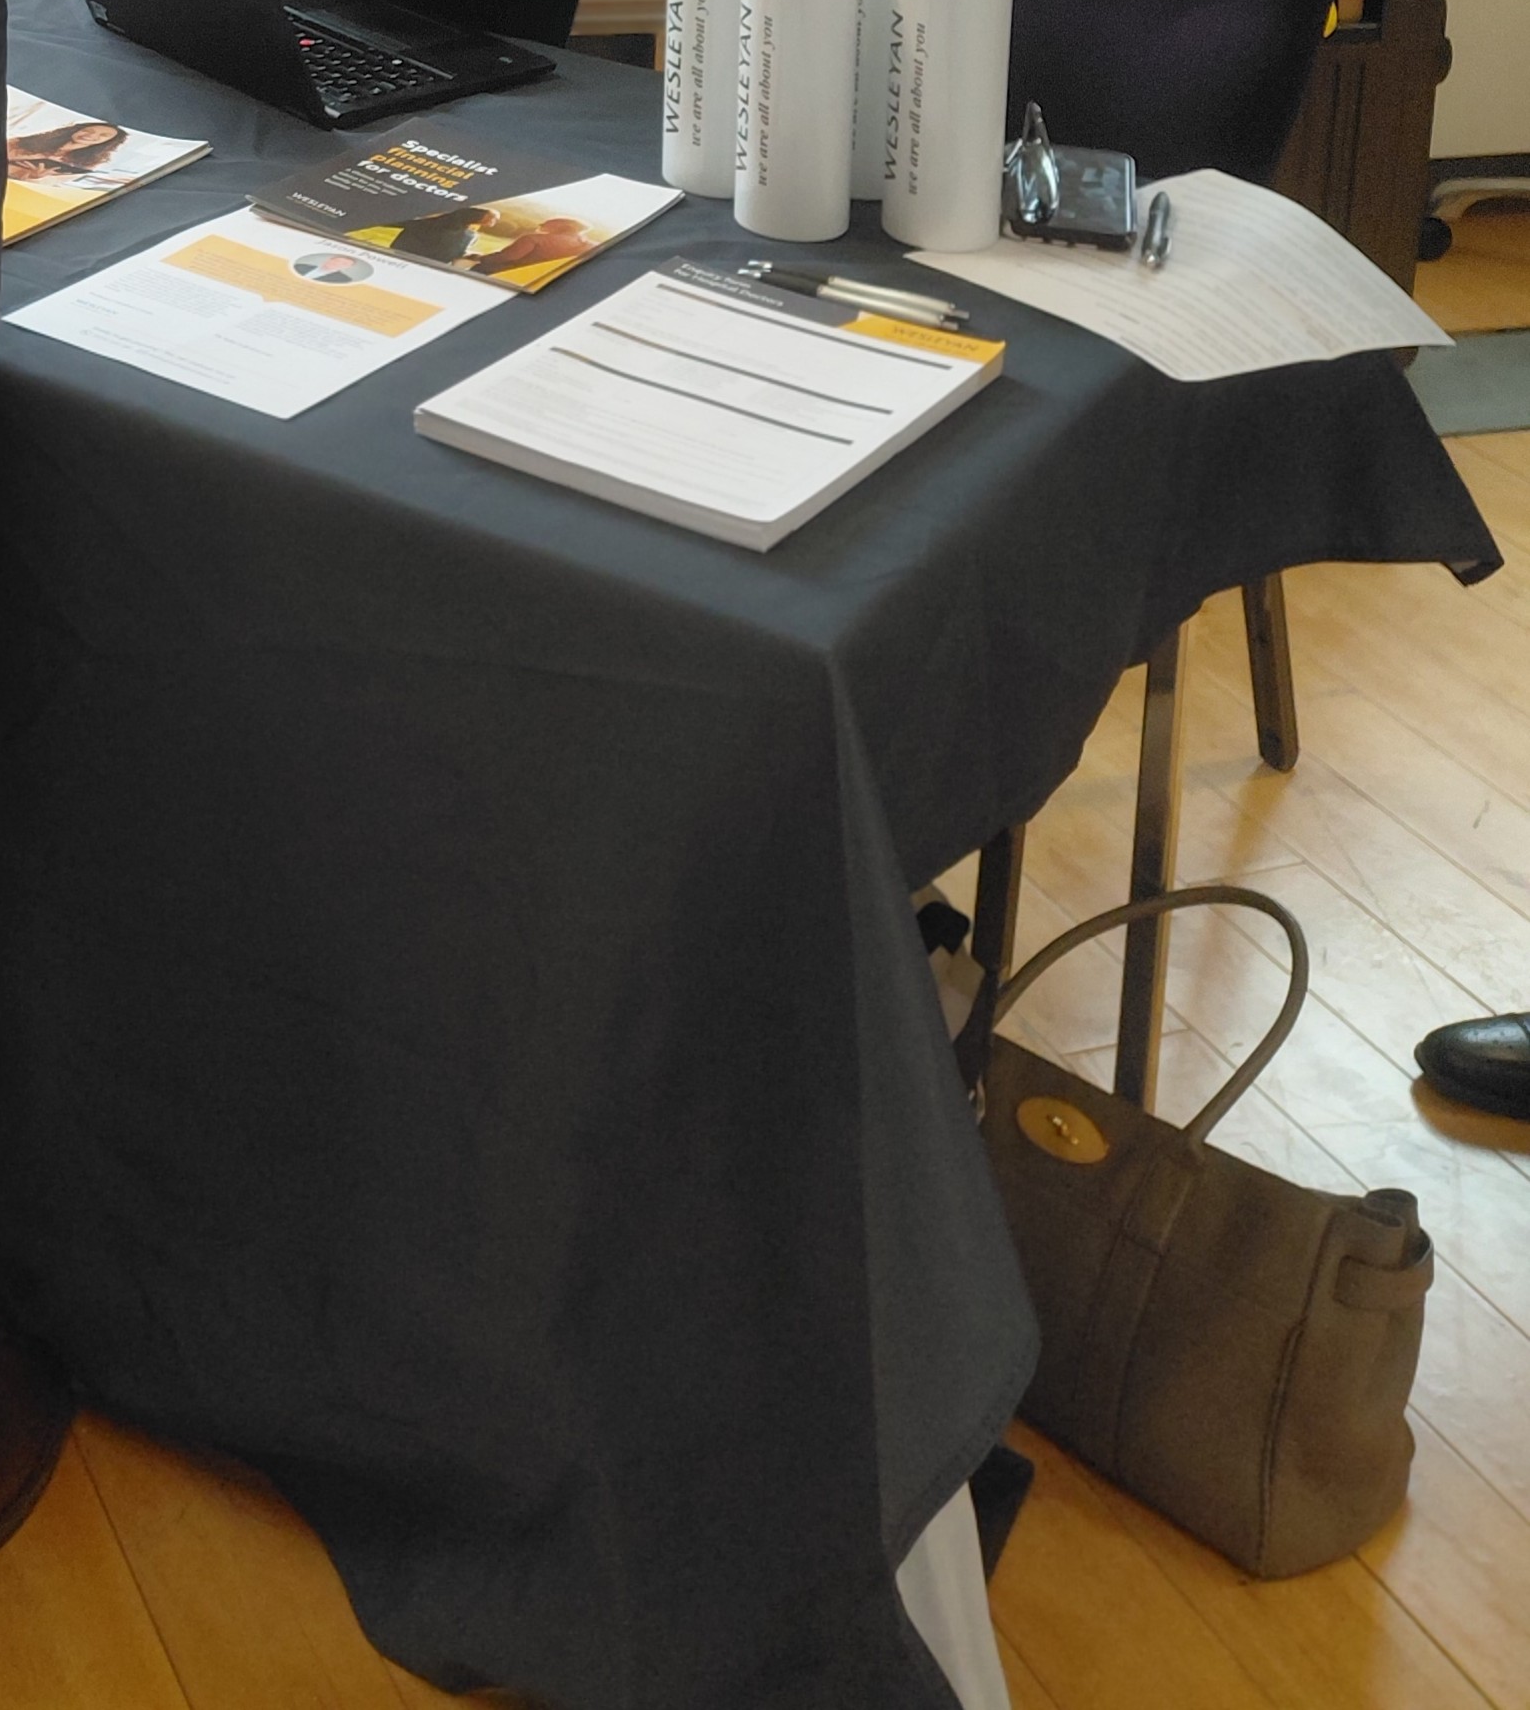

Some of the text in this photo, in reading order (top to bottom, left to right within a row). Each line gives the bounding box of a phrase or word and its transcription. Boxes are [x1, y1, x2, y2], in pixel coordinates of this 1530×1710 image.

[692, 16, 706, 64] about
[691, 64, 704, 89] all
[735, 4, 753, 171] WESLEYAN
[692, 91, 703, 122] are
[757, 14, 776, 186] we are all about you
[884, 9, 904, 180] WESLEYAN
[908, 22, 929, 195] we are all about you
[692, 123, 702, 147] we
[369, 154, 461, 189] planning
[386, 146, 475, 180] financial
[401, 139, 500, 176] Specialist
[356, 159, 391, 174] for
[389, 171, 469, 202] doctors
[291, 191, 347, 218] WESLEYAN
[358, 250, 409, 269] Powell
[893, 325, 980, 352] WESLEYAN
